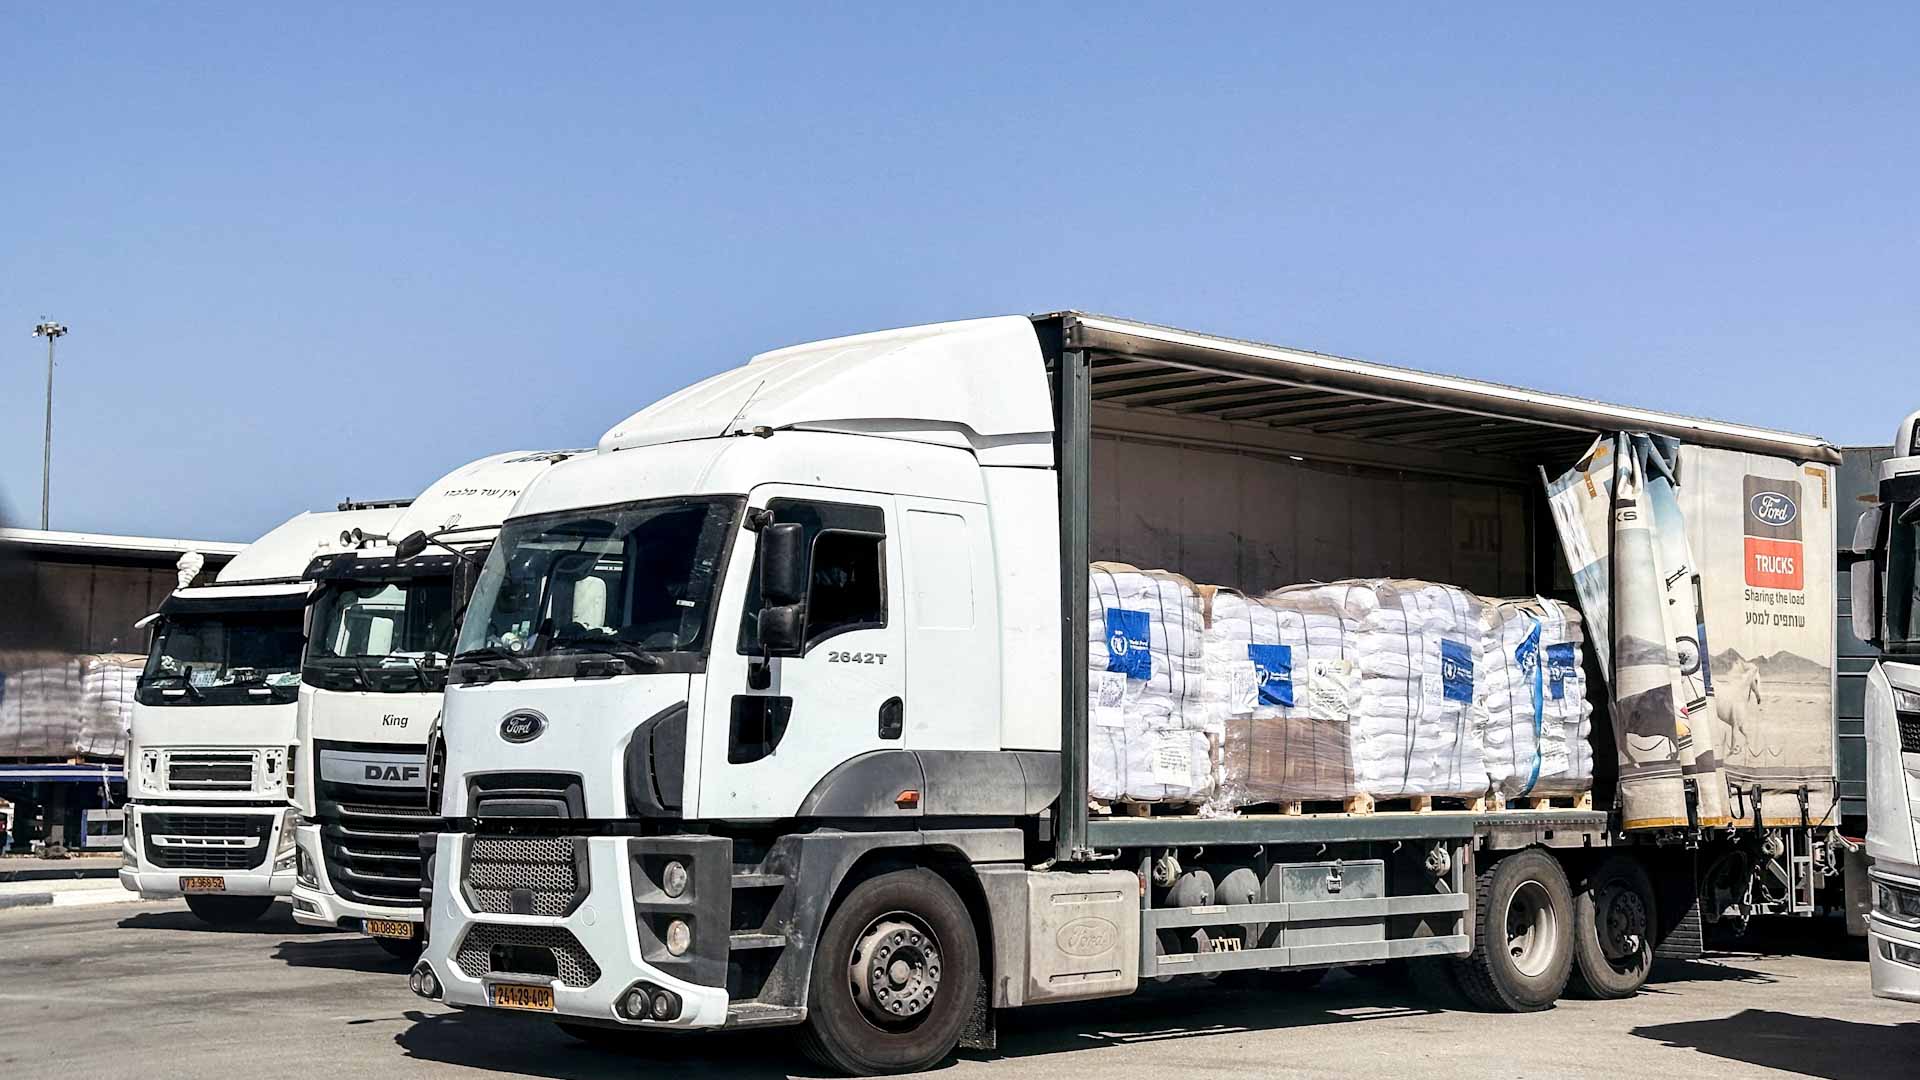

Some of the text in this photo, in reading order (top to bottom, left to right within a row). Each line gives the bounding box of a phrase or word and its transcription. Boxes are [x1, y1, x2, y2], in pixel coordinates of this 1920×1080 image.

[1758, 495, 1788, 521] Ford
[1755, 554, 1795, 575] TRUCKS
[1744, 588, 1805, 606] Sharing the load
[1745, 609, 1806, 628] שותפים למסע
[828, 651, 888, 665] 2642T
[382, 714, 409, 729] King
[506, 716, 532, 734] Ford
[364, 765, 420, 781] DAF
[1067, 923, 1107, 949] Ford
